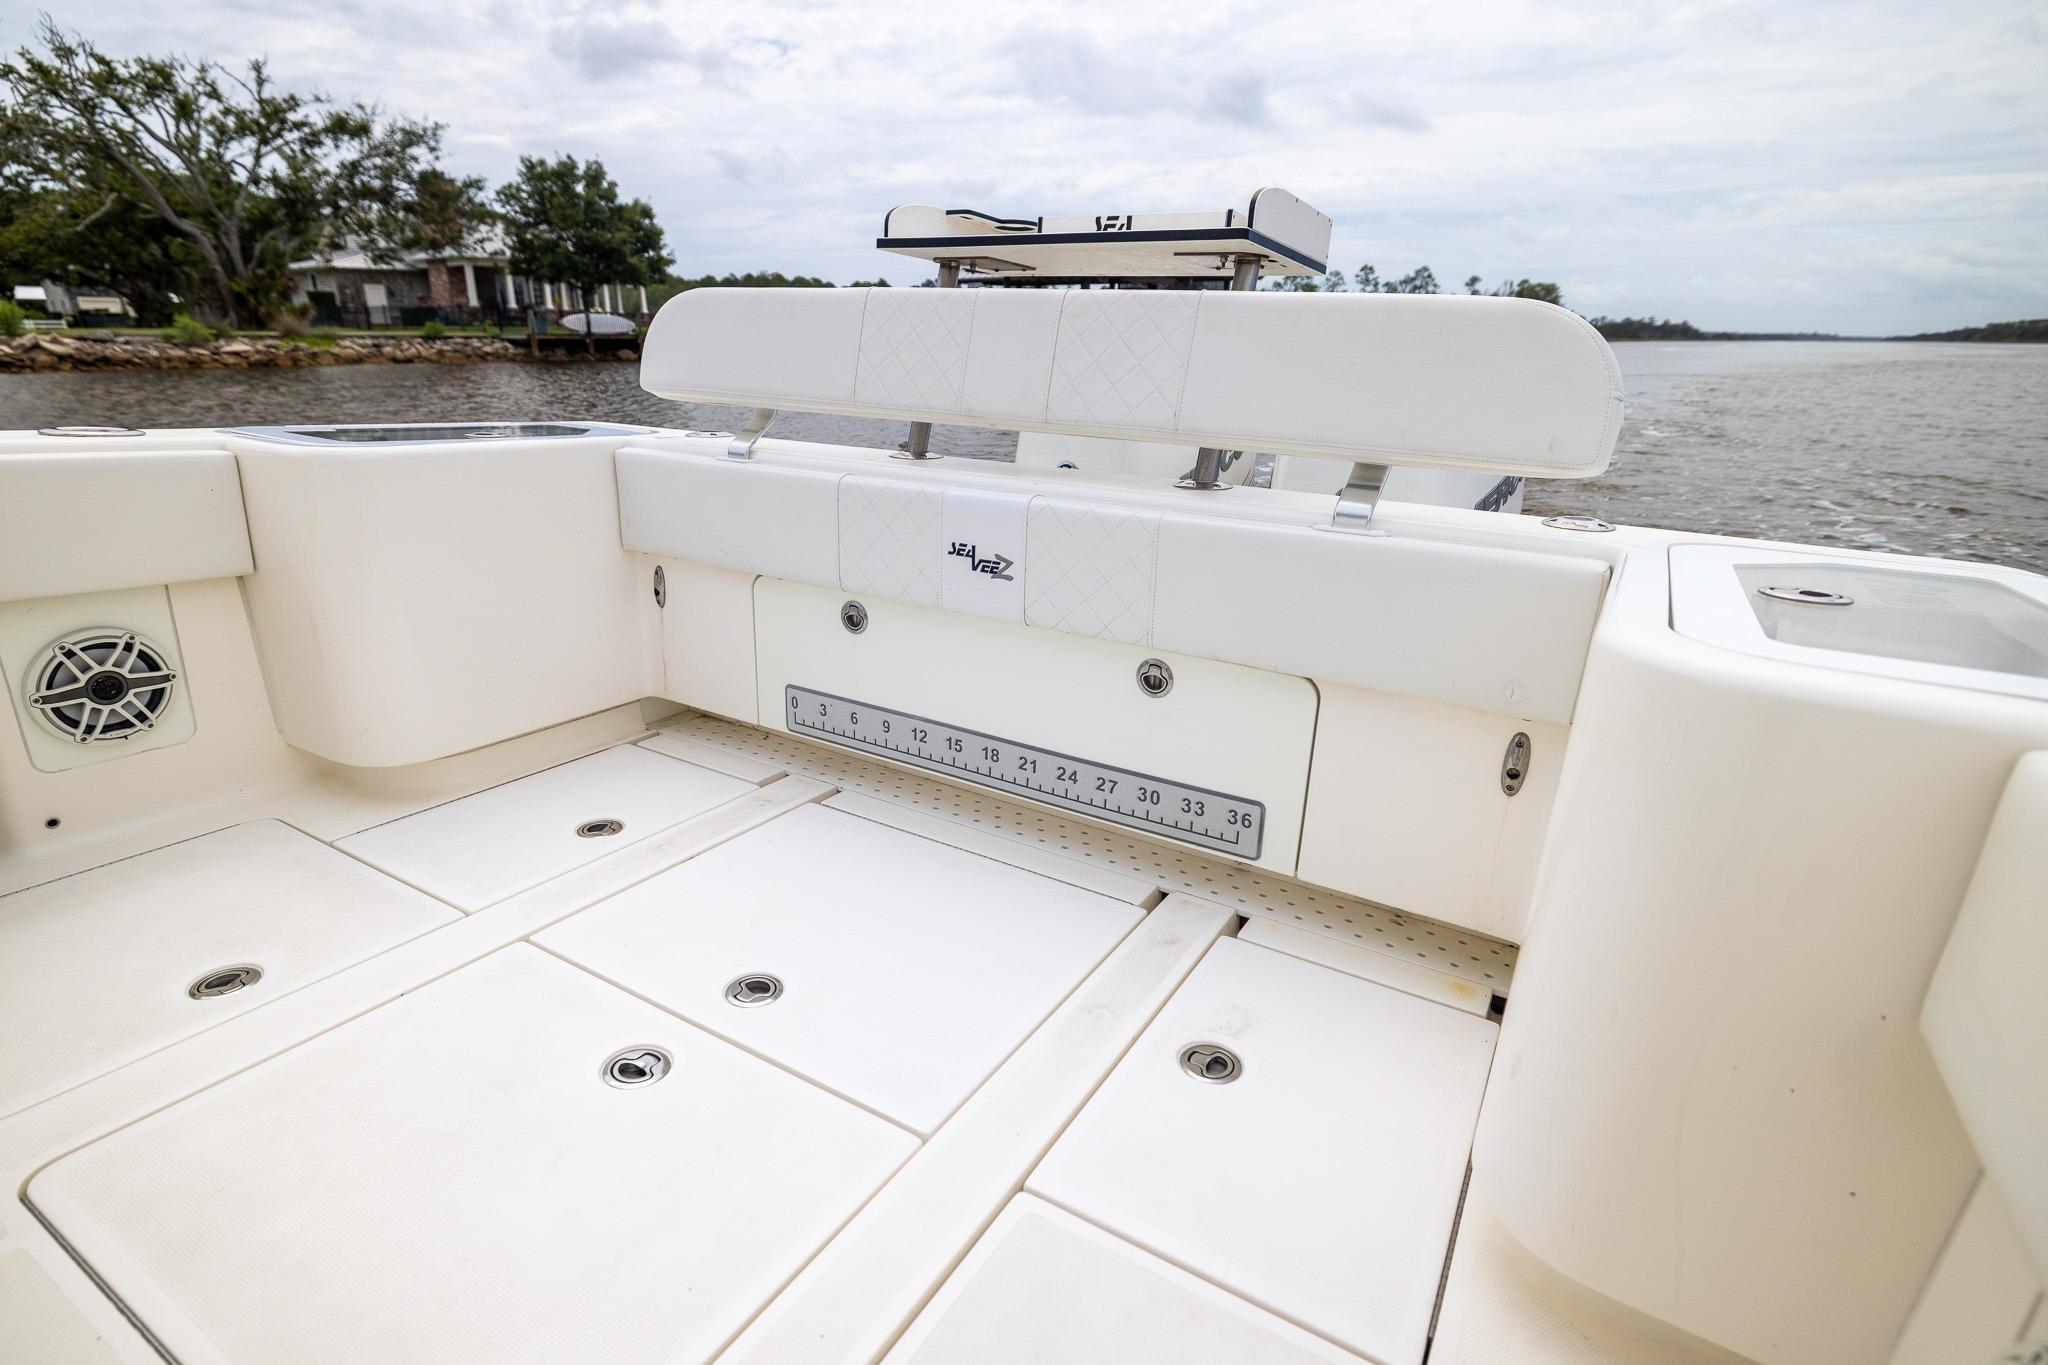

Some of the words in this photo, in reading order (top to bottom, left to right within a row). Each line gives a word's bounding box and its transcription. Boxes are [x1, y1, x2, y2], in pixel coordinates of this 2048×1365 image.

[791, 696, 799, 710] 0
[820, 703, 827, 717] 3
[851, 711, 859, 725] 6
[883, 719, 891, 734] 9
[912, 727, 928, 744] 12
[946, 736, 963, 753] 15
[982, 746, 1000, 763] 18
[1019, 756, 1037, 774] 21
[1057, 766, 1079, 785] 24
[1096, 776, 1118, 795] 27
[1138, 787, 1161, 806] 30
[1182, 797, 1206, 817] 33
[1227, 809, 1253, 829] 36
